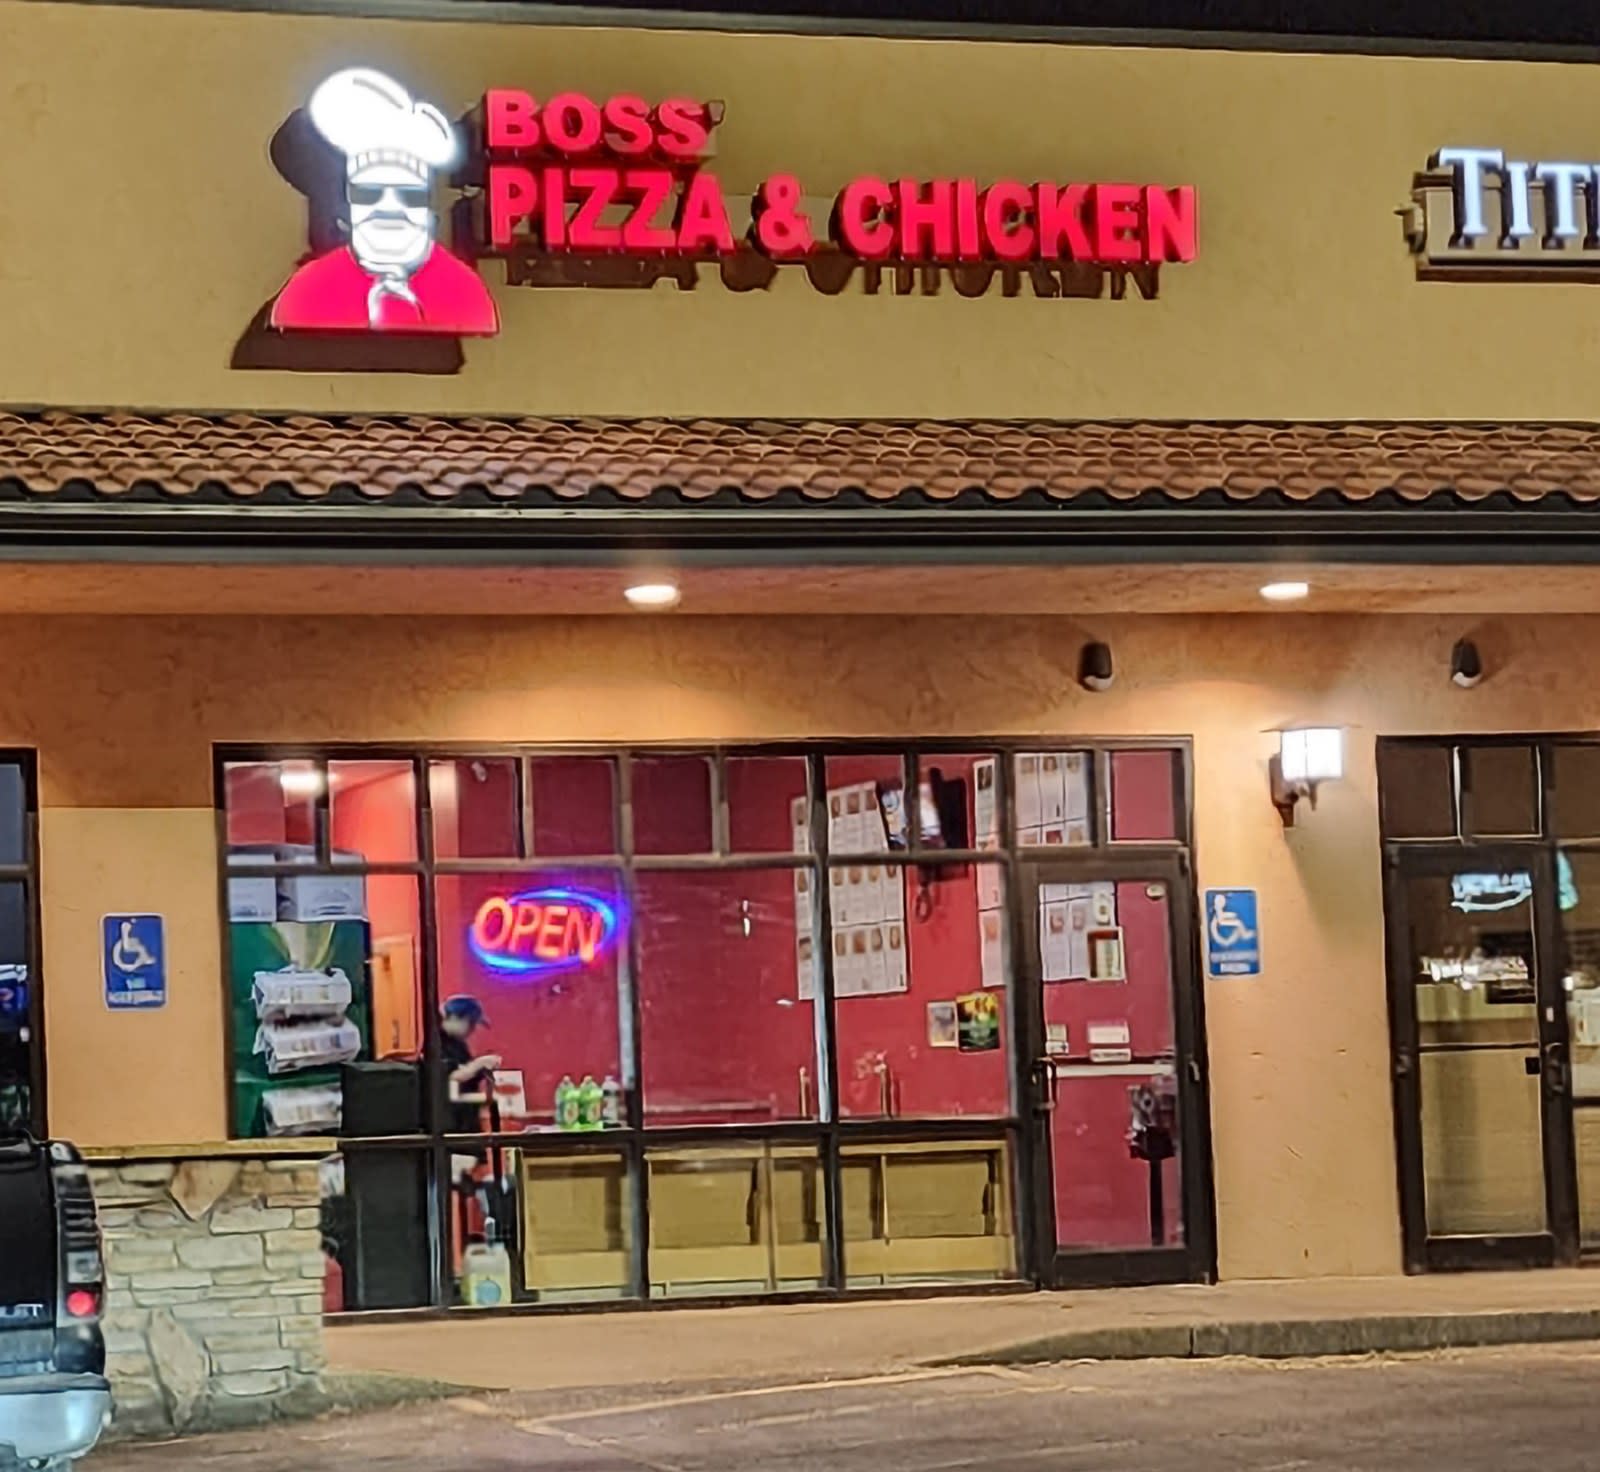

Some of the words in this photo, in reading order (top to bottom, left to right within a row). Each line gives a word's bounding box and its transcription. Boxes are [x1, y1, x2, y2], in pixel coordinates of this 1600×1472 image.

[487, 88, 709, 155] BOSS
[489, 166, 734, 249] PIZZA
[758, 172, 814, 250] &
[842, 175, 1197, 262] CHICKEN
[1439, 147, 1600, 236] TIT
[474, 897, 604, 962] OPEN
